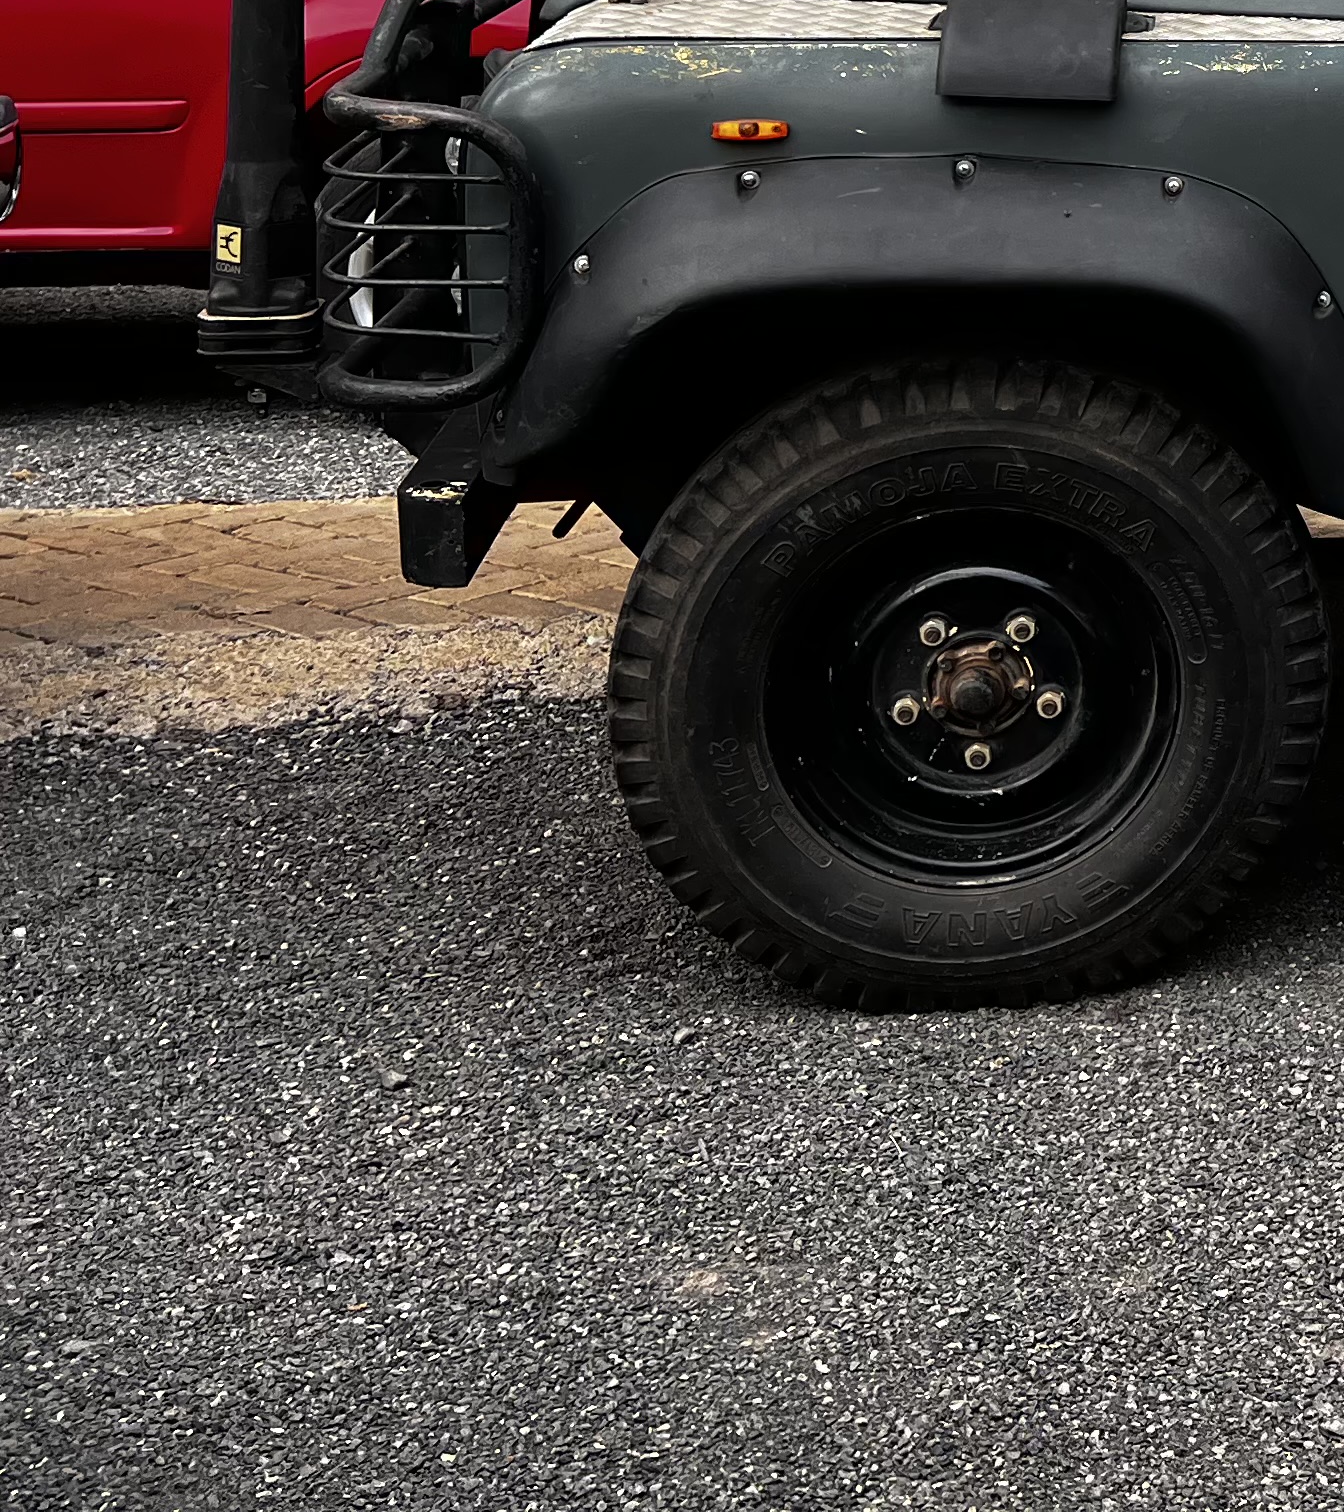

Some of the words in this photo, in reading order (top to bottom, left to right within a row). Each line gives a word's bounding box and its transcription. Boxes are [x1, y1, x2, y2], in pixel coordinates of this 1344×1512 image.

[215, 261, 241, 275] CODAN
[760, 462, 978, 578] PAMOJA
[993, 462, 1158, 552] EXTRA
[708, 737, 776, 848] TKL11743
[902, 893, 1078, 947] YANA
